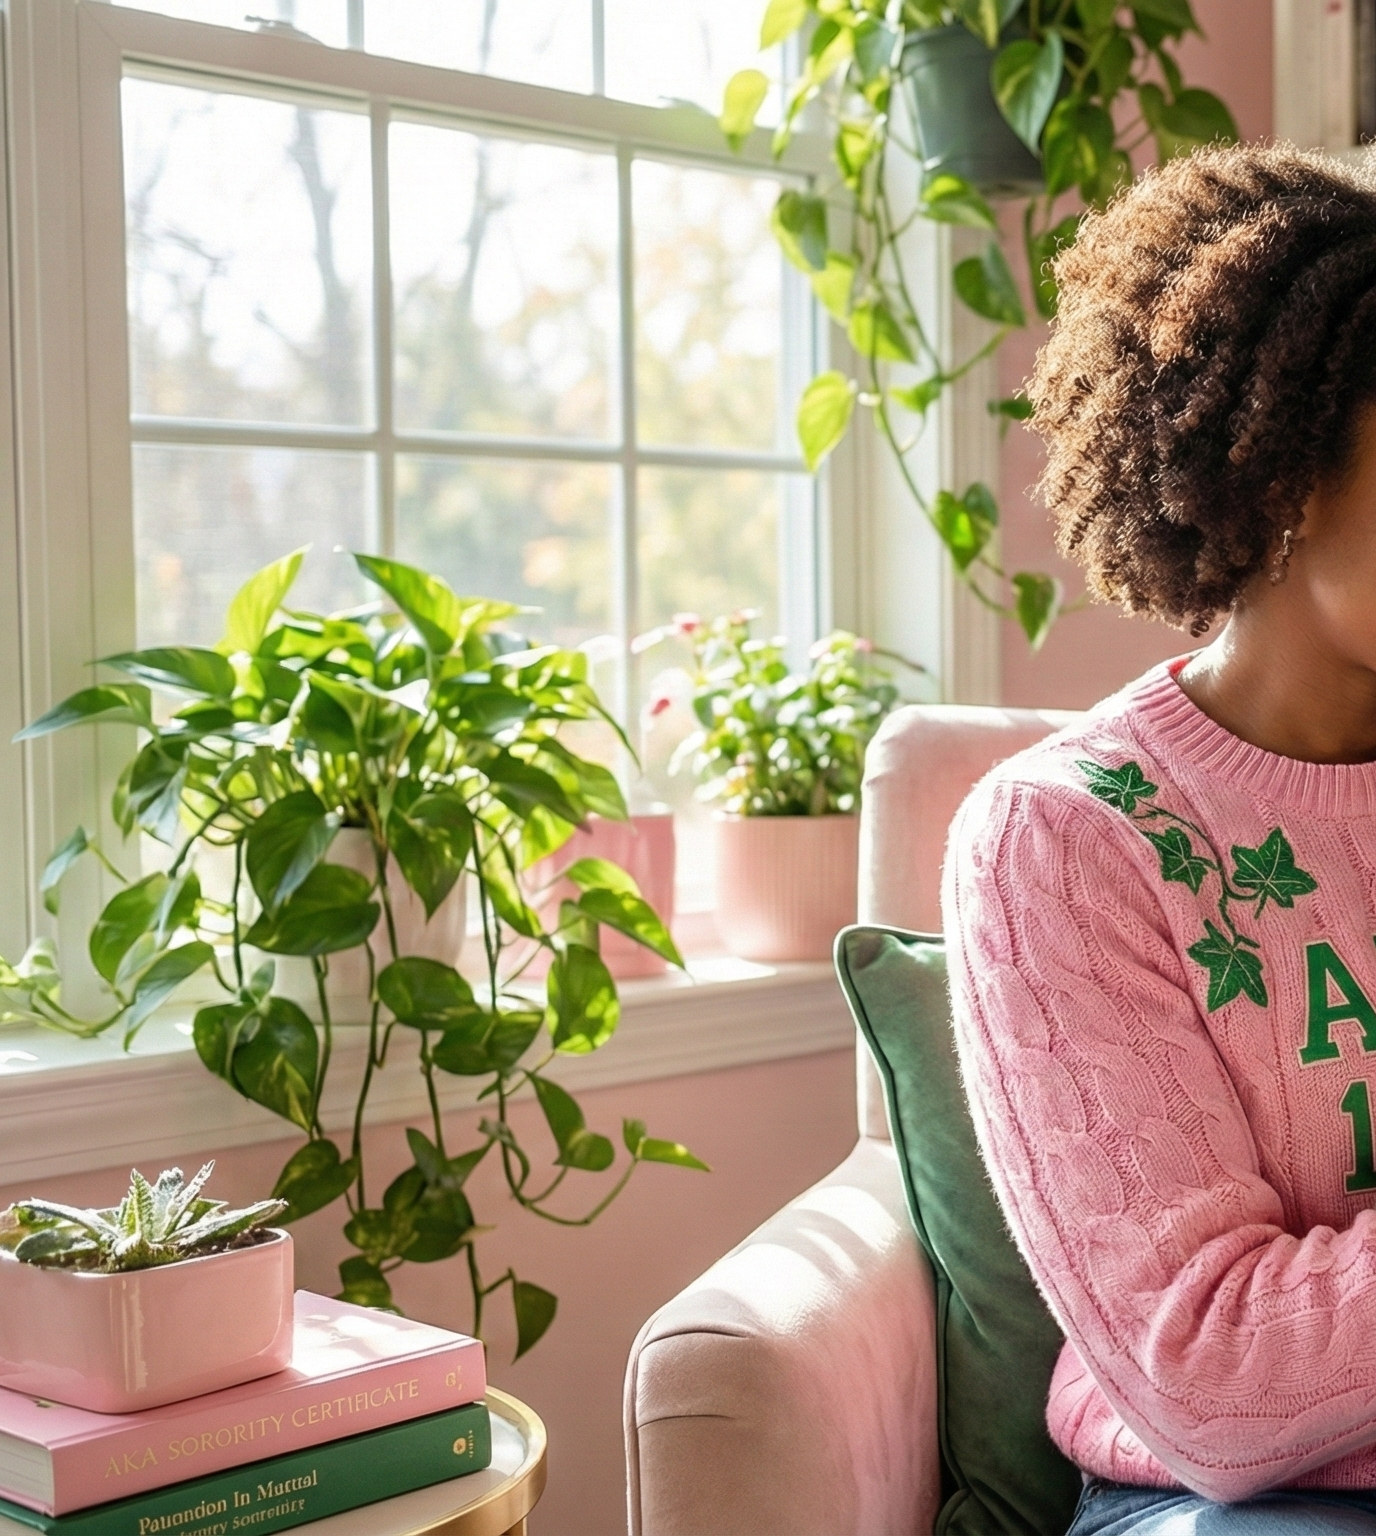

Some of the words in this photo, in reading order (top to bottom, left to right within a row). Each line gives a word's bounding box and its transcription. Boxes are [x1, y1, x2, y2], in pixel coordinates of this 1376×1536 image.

[104, 1447, 158, 1478] AKA
[168, 1413, 285, 1461] SORORITY
[292, 1379, 420, 1428] CERTIFICATE
[233, 1491, 251, 1509] In
